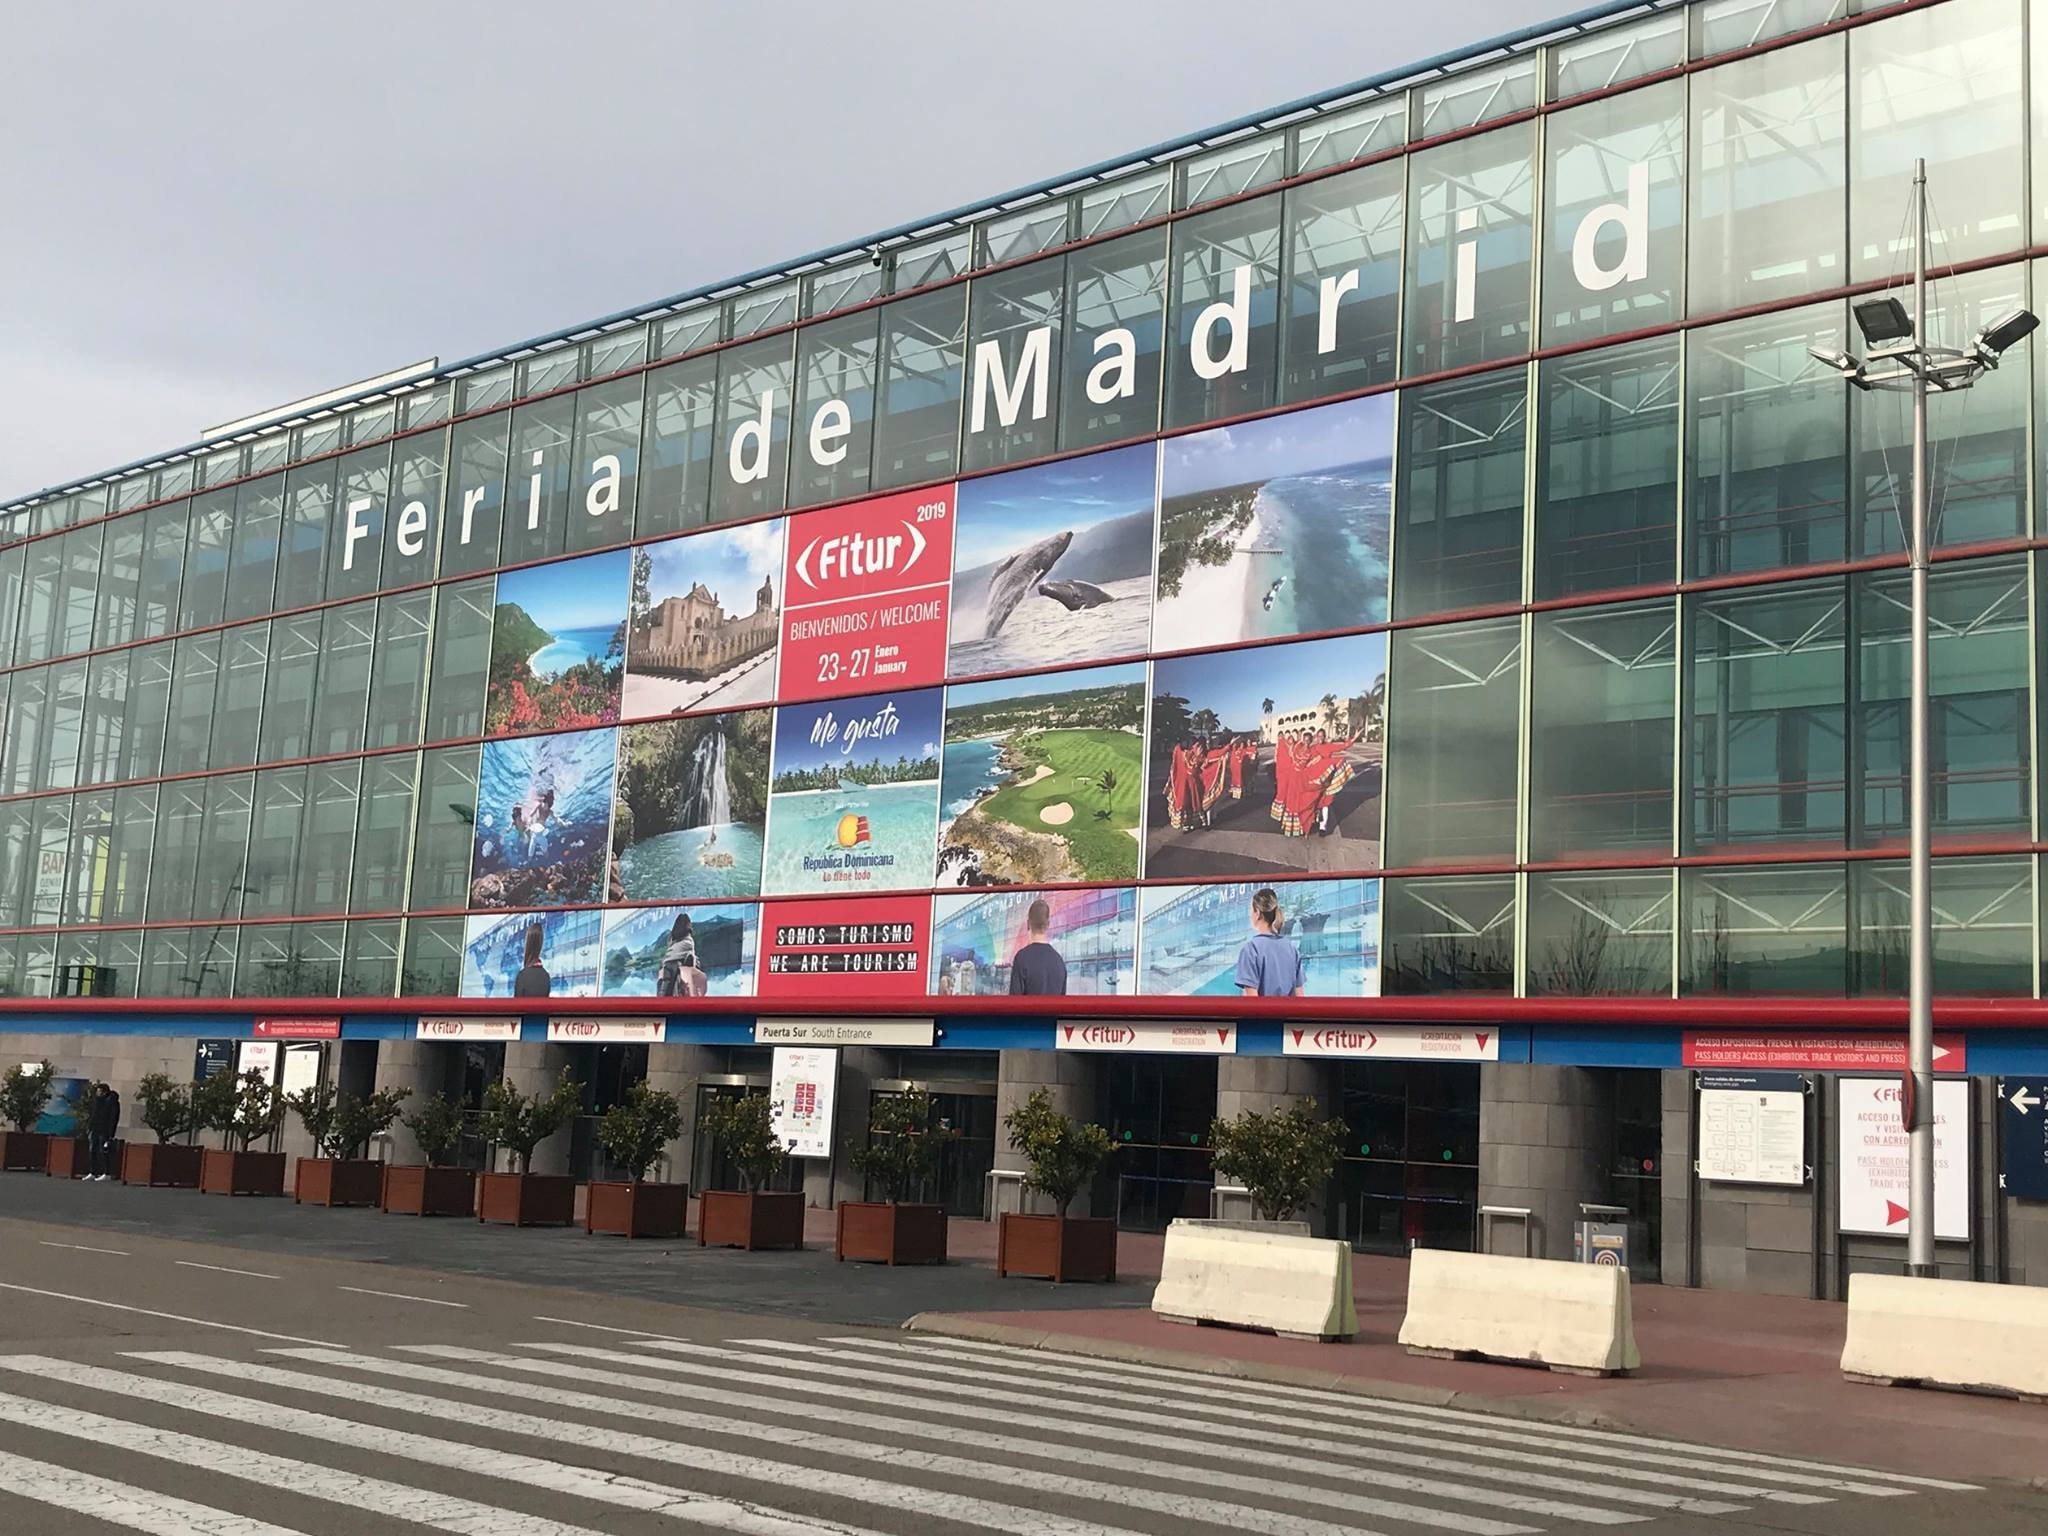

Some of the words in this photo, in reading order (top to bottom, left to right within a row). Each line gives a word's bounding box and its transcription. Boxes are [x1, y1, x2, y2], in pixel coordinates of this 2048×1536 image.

[343, 450, 621, 570] Feria
[729, 389, 852, 484] de
[970, 161, 1651, 434] Madrid
[917, 501, 946, 523] 2019
[790, 612, 869, 641] BIENVENIDOS
[880, 600, 942, 627] WELCOME
[875, 645, 899, 658] Enero
[874, 659, 907, 675] January
[810, 712, 840, 748] Me
[841, 701, 900, 754] gusta
[845, 852, 894, 868] Dominicana
[778, 928, 826, 946] SOMOS
[840, 924, 913, 943] TURISMO
[770, 955, 788, 972] WE
[801, 955, 829, 972] ARE
[844, 953, 918, 972] TOURISM
[763, 1027, 790, 1037] Puerta
[793, 1027, 807, 1038] Sur
[812, 1027, 835, 1038] South
[837, 1027, 872, 1039] Entrance
[1696, 1038, 1720, 1047] ACCESO
[1767, 1039, 1792, 1048] PRENSA
[1801, 1040, 1837, 1049] VISITANTES
[1695, 1051, 1711, 1060] PASS
[1712, 1051, 1741, 1060] HOLDERS
[1742, 1051, 1767, 1061] ACCESS
[1812, 1053, 1832, 1062] TRADE
[1833, 1053, 1865, 1063] VISITORS
[1866, 1053, 1879, 1063] AND
[1858, 1113, 1889, 1122] ACCESO
[1863, 1135, 1880, 1145] CON
[1857, 1156, 1877, 1165] PASS
